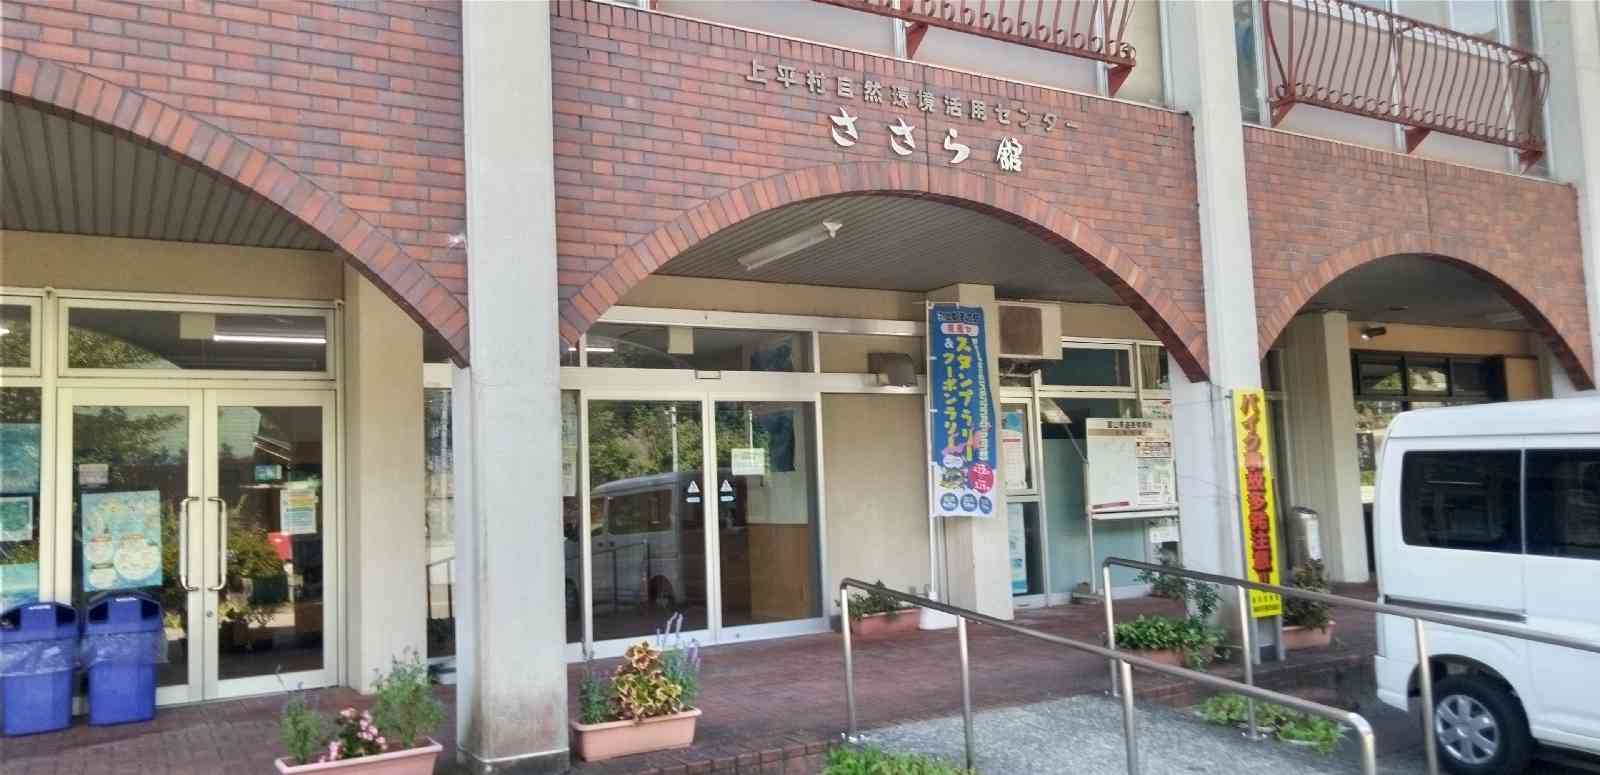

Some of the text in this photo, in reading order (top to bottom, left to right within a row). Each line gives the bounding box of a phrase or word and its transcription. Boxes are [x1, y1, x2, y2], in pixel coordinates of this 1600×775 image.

[746, 59, 1079, 130] 上平村自然環境活用センター
[829, 105, 1024, 171] ささら館
